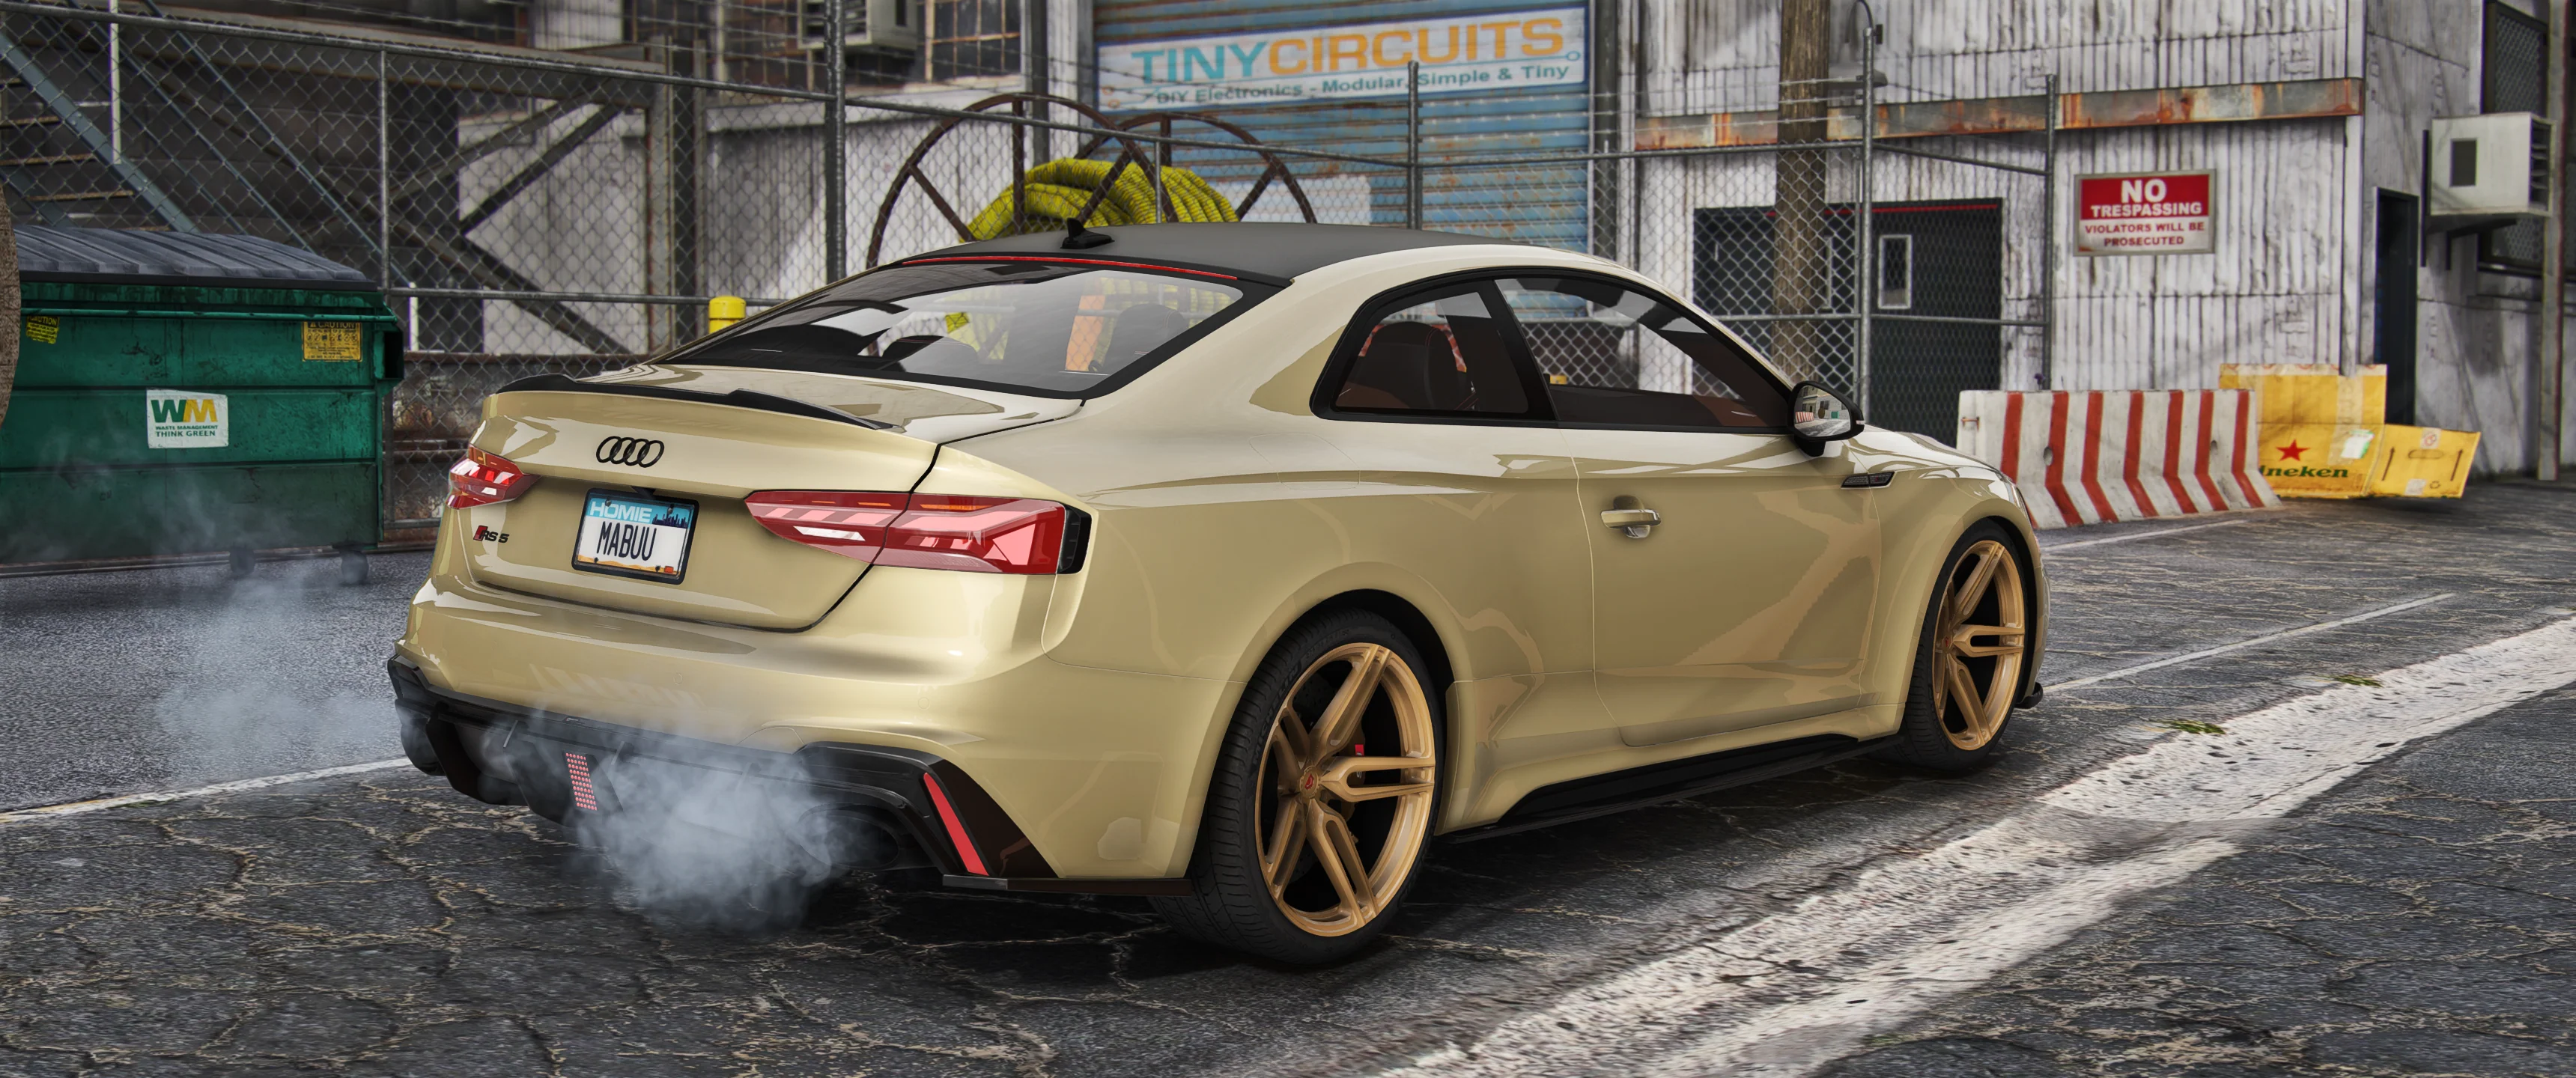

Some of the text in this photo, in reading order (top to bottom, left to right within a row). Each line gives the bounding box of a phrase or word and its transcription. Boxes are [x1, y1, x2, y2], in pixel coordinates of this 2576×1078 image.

[1131, 17, 1564, 84] TINYCIRCUITS
[1157, 89, 1189, 104] DIY
[1195, 83, 1303, 103] Electronics
[1417, 70, 1490, 88] Simple
[1498, 67, 1513, 81] &
[1521, 65, 1570, 81] Tiny
[2121, 178, 2167, 204] NO
[2090, 201, 2203, 218] TRESPASSING
[2085, 222, 2205, 234] VIOLATORS WILL BE
[2103, 236, 2184, 247] PROSECUTED
[151, 398, 218, 424] WM
[2258, 465, 2349, 478] ineken
[589, 501, 652, 523] HOMIE
[596, 520, 657, 561] MABUU
